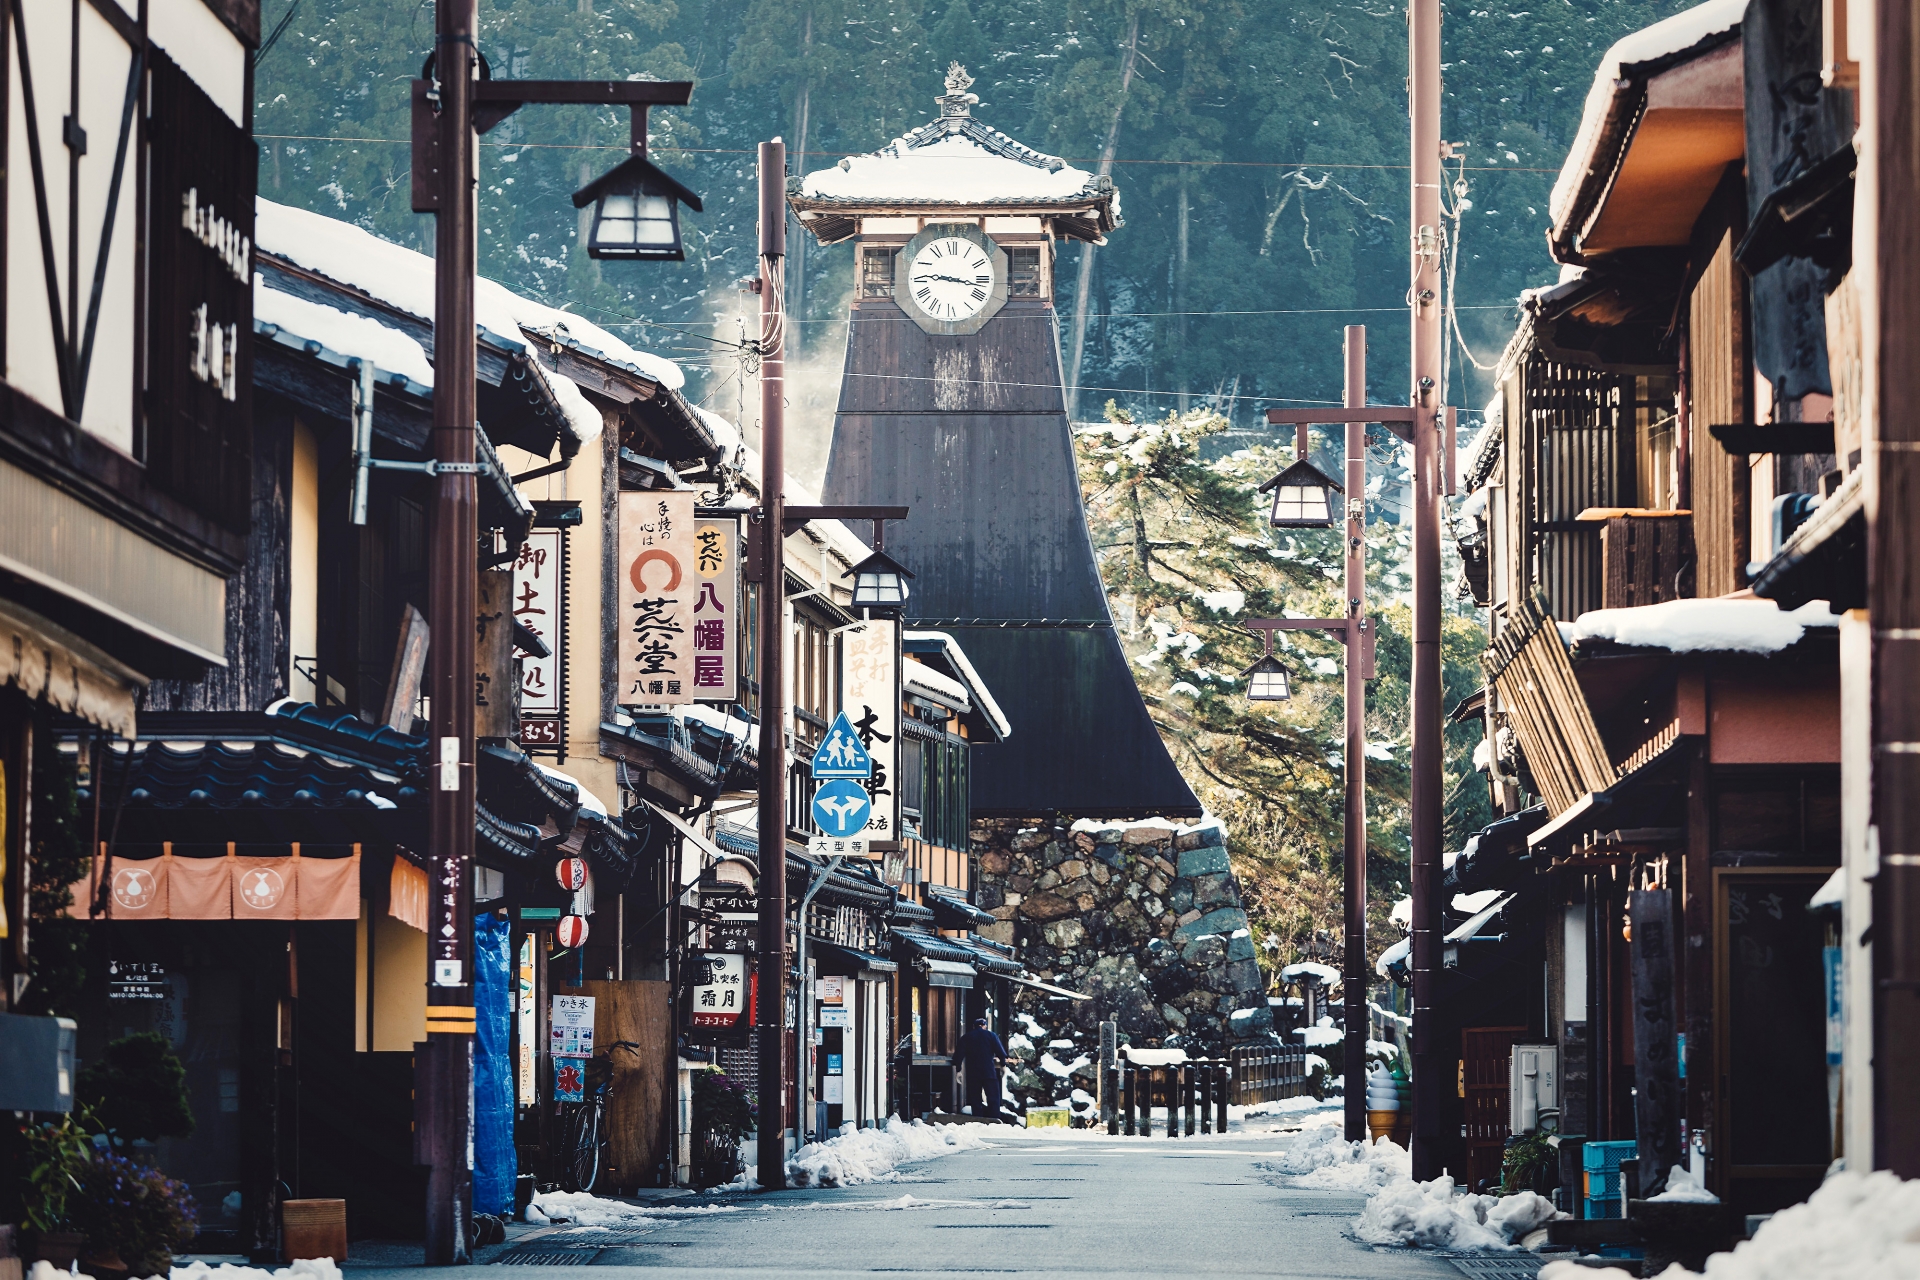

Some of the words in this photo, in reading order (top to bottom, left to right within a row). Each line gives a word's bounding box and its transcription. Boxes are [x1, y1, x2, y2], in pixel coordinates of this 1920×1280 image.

[657, 500, 673, 540] 手焼の
[640, 523, 655, 546] 心は
[696, 531, 723, 572] せんべい
[694, 582, 725, 688] 八幡屋
[868, 625, 890, 682] 手打
[631, 680, 682, 695] 八幡屋
[521, 721, 556, 741] むら
[817, 840, 863, 852] 大型等
[711, 973, 740, 985] 風喫茶
[559, 998, 589, 1010] かき氷
[701, 989, 735, 1008] 霜月
[557, 1064, 584, 1094] 氷
